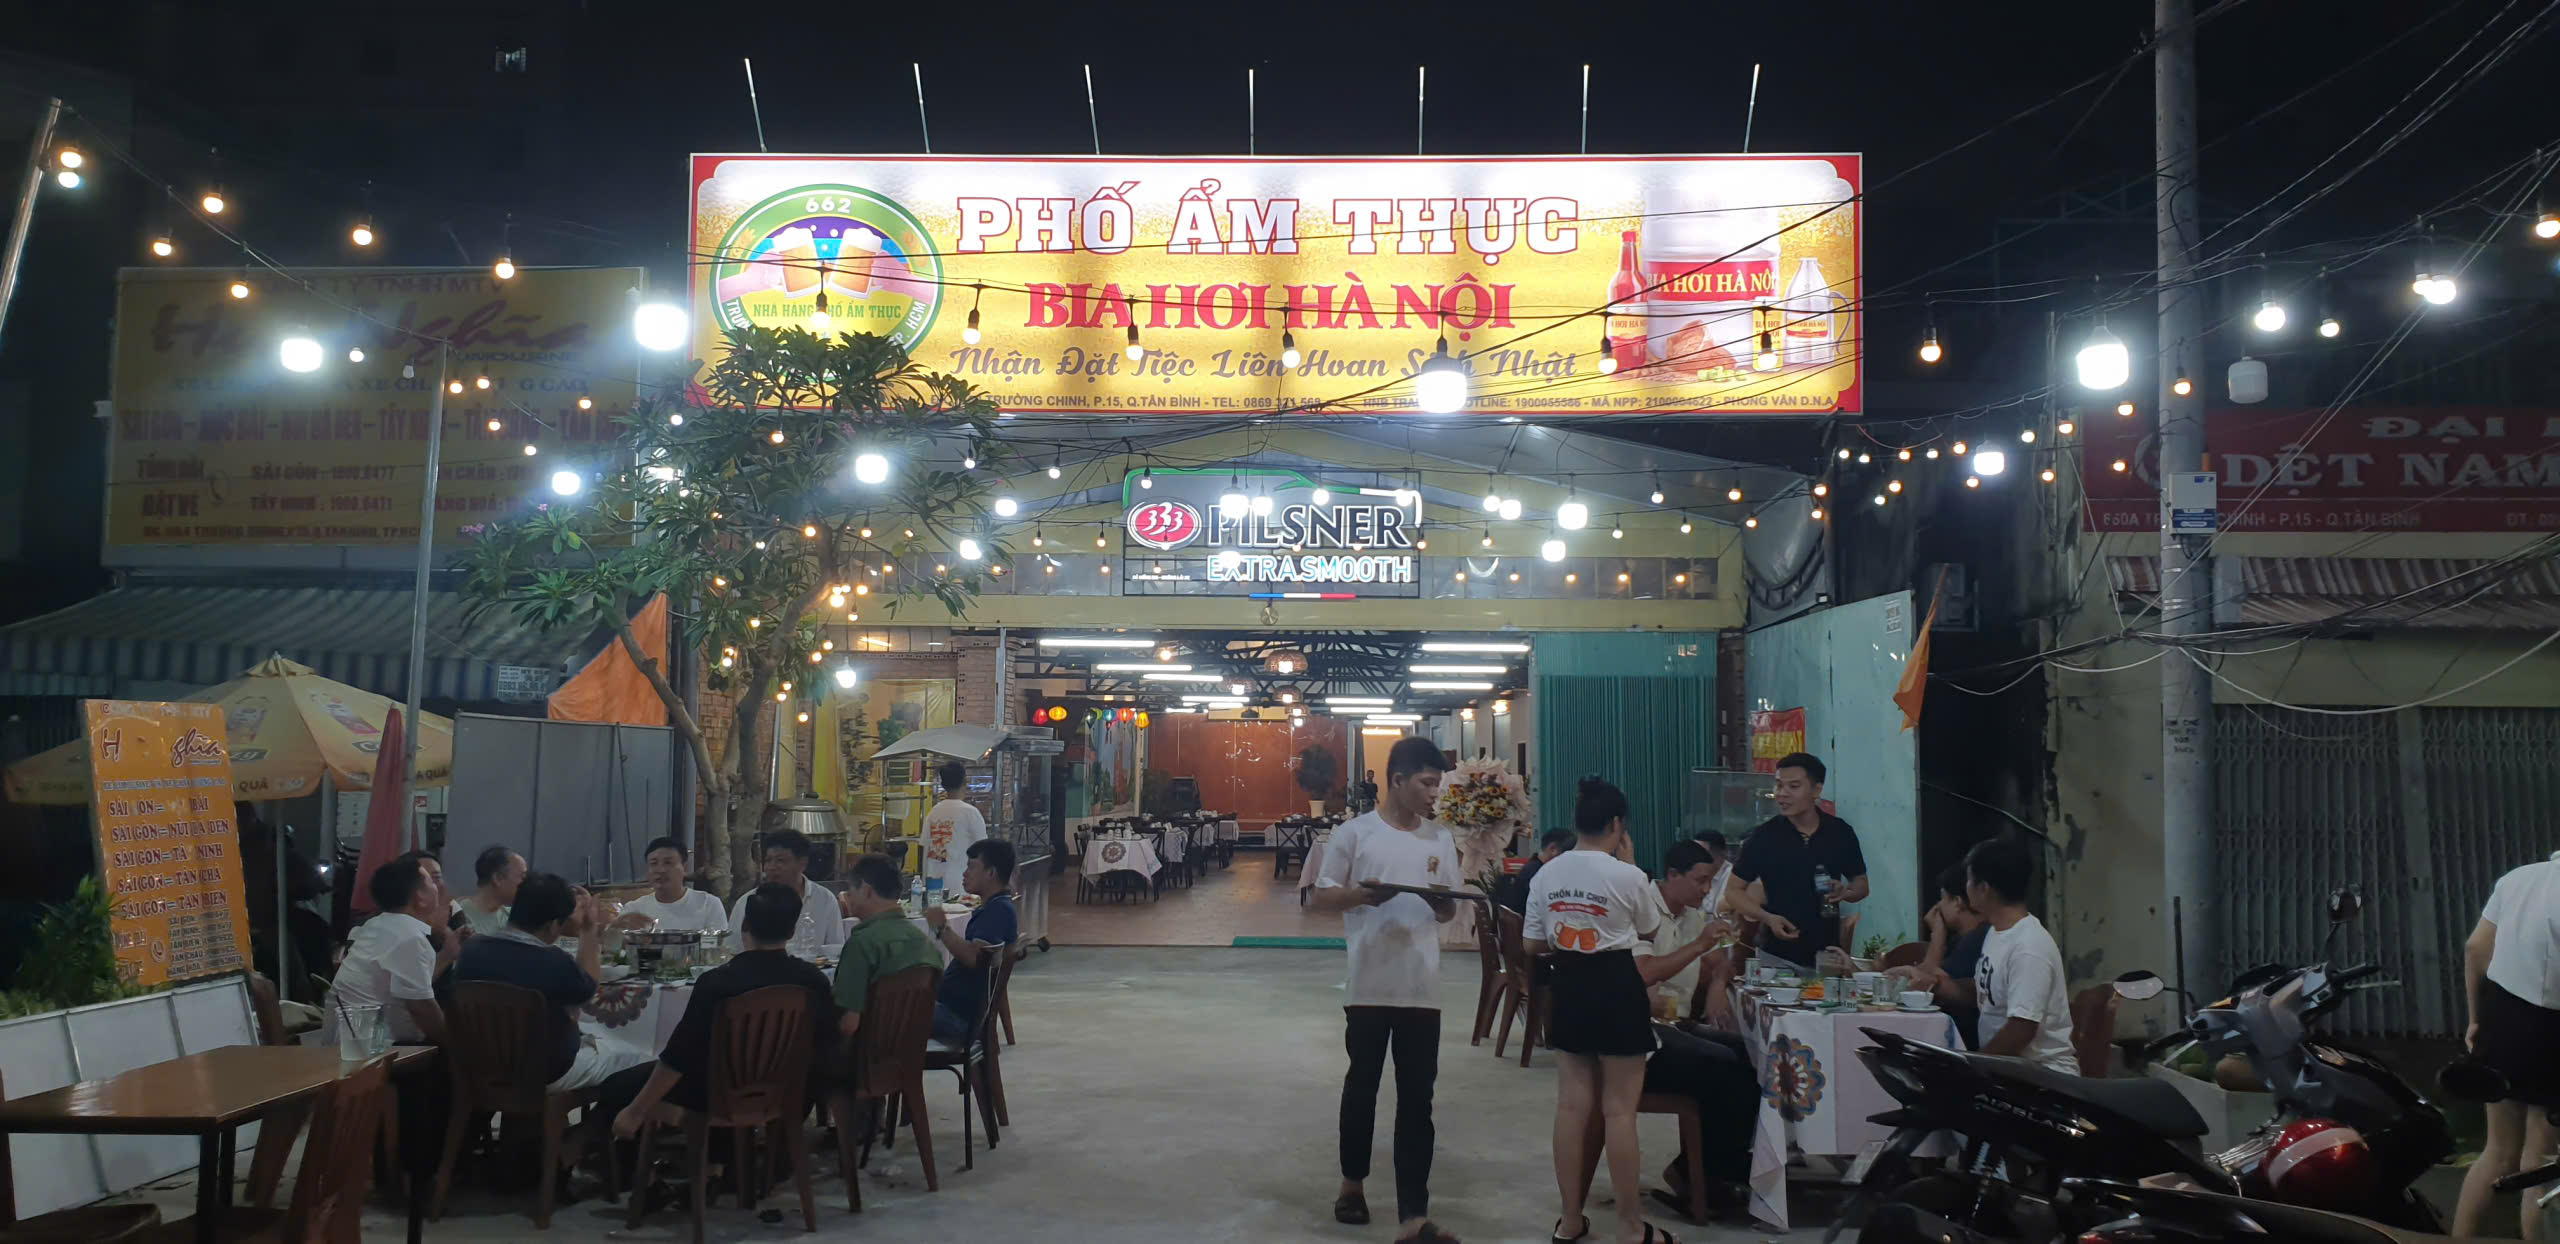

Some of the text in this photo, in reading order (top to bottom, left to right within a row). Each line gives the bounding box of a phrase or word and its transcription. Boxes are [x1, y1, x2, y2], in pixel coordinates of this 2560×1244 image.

[804, 196, 852, 214] 662
[956, 178, 1578, 266] PHỐ ẨM THỰC
[1672, 270, 1712, 293] HƠI
[1716, 265, 1747, 293] HÀ
[1749, 264, 1776, 293] NỘI
[904, 301, 927, 330] HCM
[1024, 271, 1515, 342] BIA HƠI HÀ NỘI
[950, 347, 1045, 384] Nhận
[1056, 347, 1121, 384] Đặt
[1130, 346, 1198, 384] Tiệc
[1210, 347, 1288, 377] Liên
[1297, 348, 1389, 378] Hoan
[1488, 345, 1578, 384] Nhật
[1047, 394, 1090, 408] CHINH,
[1094, 395, 1123, 409] P.15,
[1171, 393, 1201, 407] BÌNH
[1213, 396, 1240, 407] TEL:
[1243, 396, 1272, 407] 0869
[1465, 397, 1510, 407] OTLINE:
[1613, 397, 1641, 408] NPP:
[2360, 416, 2504, 443] ĐẠI
[2222, 442, 2560, 497] DỆT NAM
[1207, 504, 1413, 548] PILSNER
[2279, 513, 2312, 528] P.15
[1299, 555, 1412, 583] SMOOTH
